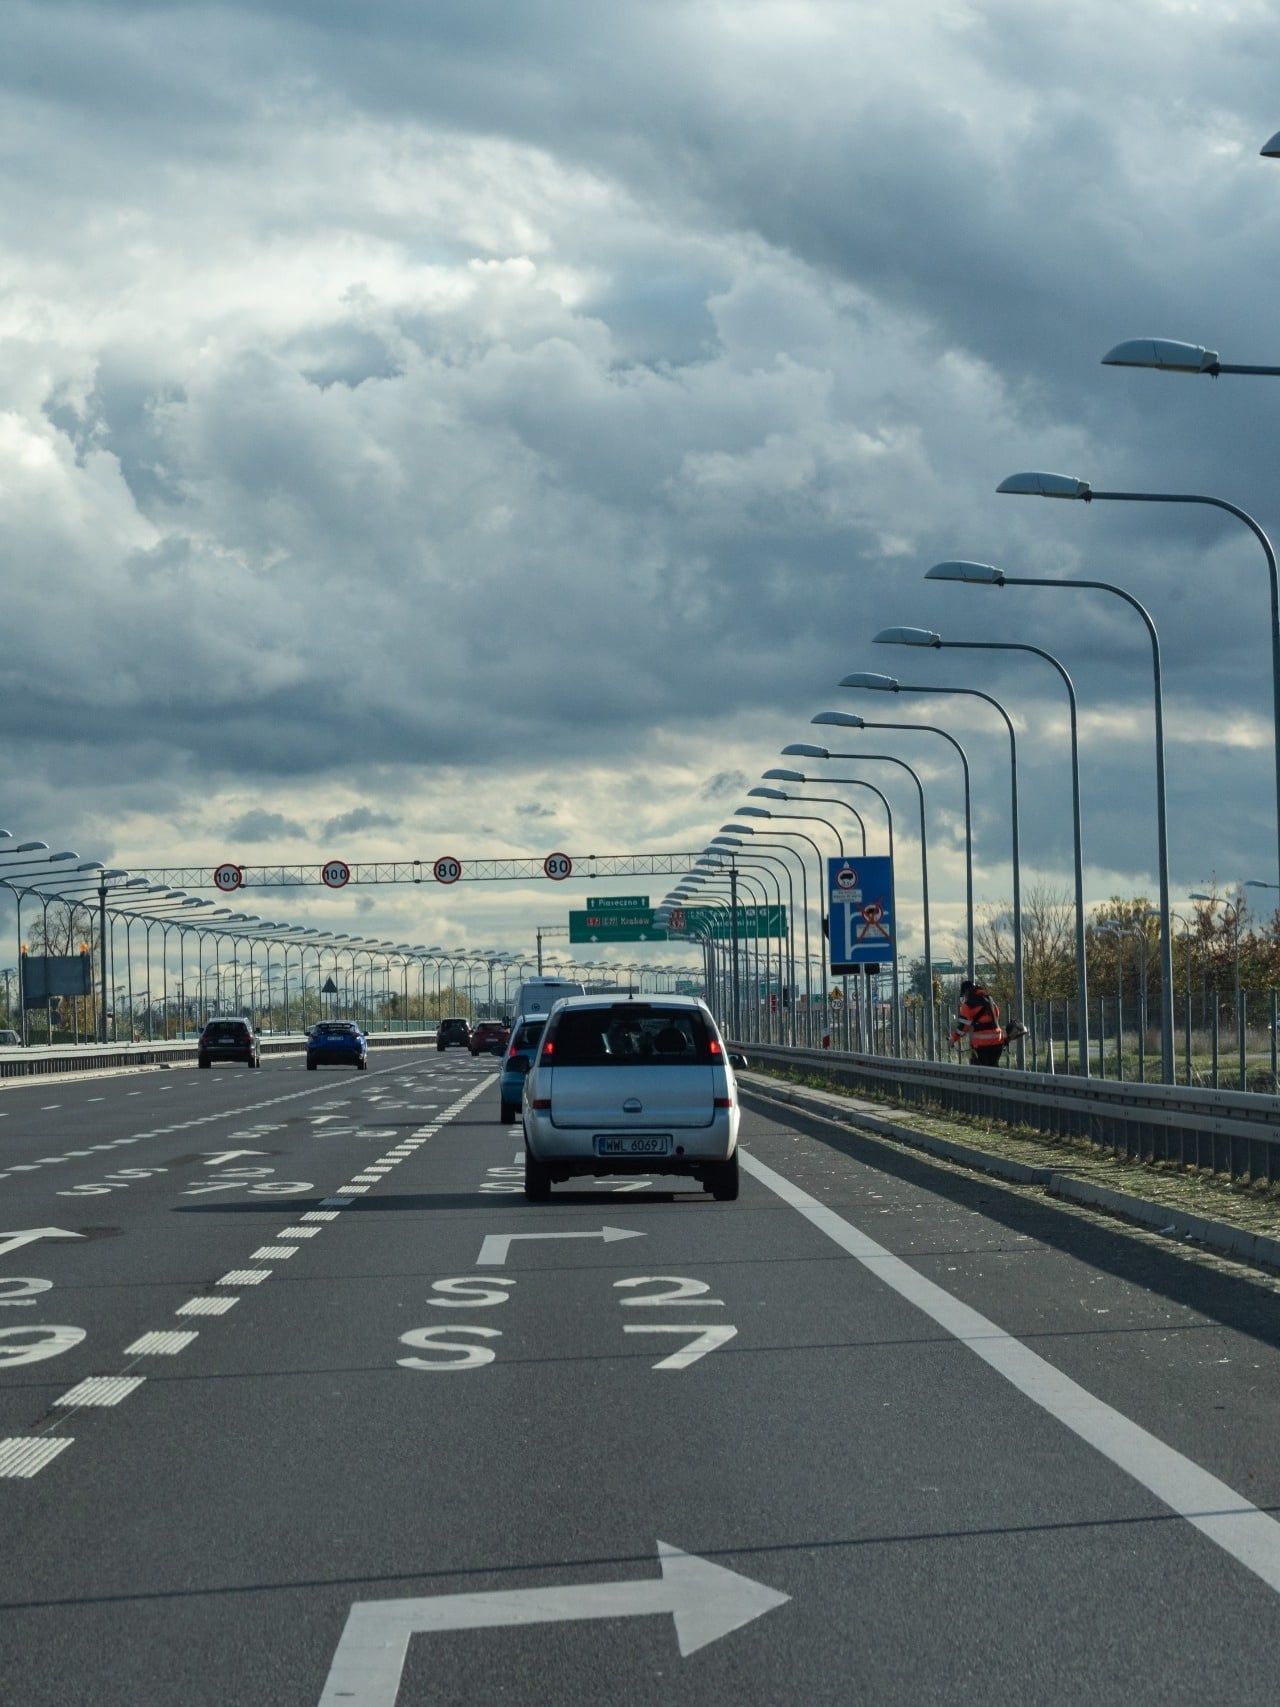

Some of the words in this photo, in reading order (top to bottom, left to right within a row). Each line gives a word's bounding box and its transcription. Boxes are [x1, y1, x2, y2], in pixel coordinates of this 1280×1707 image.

[437, 864, 458, 877] 80
[548, 860, 568, 873] 80
[217, 871, 239, 883] 100
[325, 869, 347, 880] 100
[598, 899, 638, 907] Piaseczno
[606, 1138, 628, 1151] WWL
[104, 1167, 168, 1179] S
[208, 1167, 275, 1178] 2
[56, 1183, 129, 1196] S
[181, 1182, 315, 1195] 79
[426, 1276, 517, 1308] S
[613, 1276, 726, 1307] 2
[396, 1324, 503, 1371] S
[623, 1324, 739, 1370] 7
